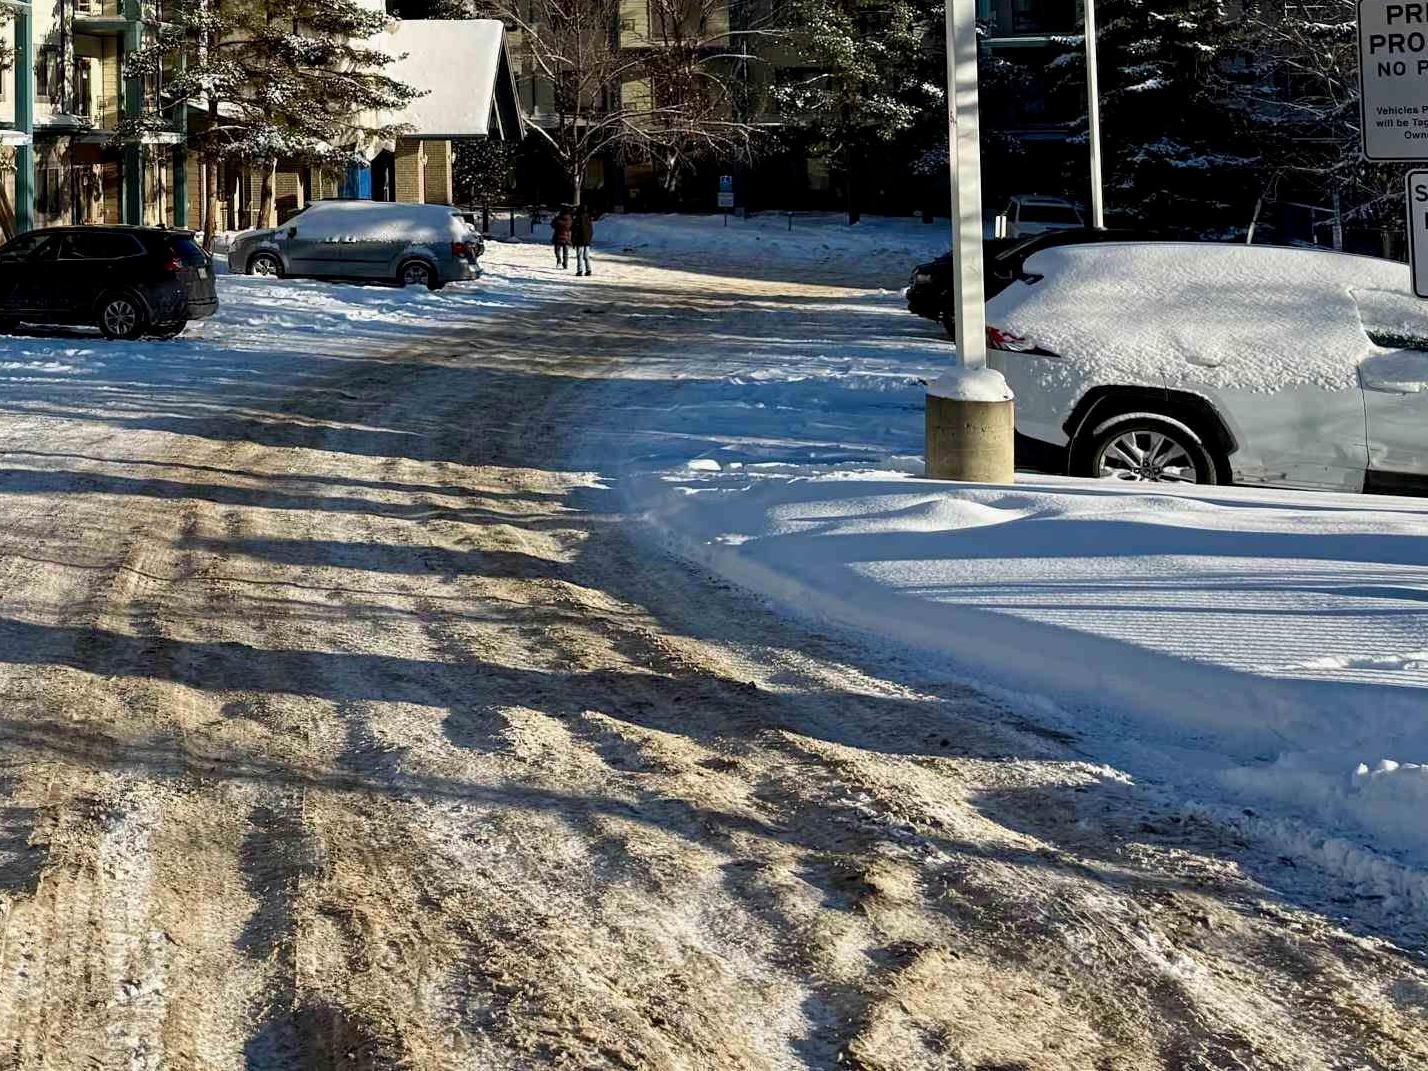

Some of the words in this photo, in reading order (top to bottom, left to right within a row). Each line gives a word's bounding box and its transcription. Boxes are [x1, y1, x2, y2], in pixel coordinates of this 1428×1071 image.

[1370, 32, 1425, 54] PRO
[1378, 61, 1406, 77] NO
[1376, 105, 1419, 115] Vehicles
[1376, 119, 1393, 127] will
[1397, 119, 1409, 127] be
